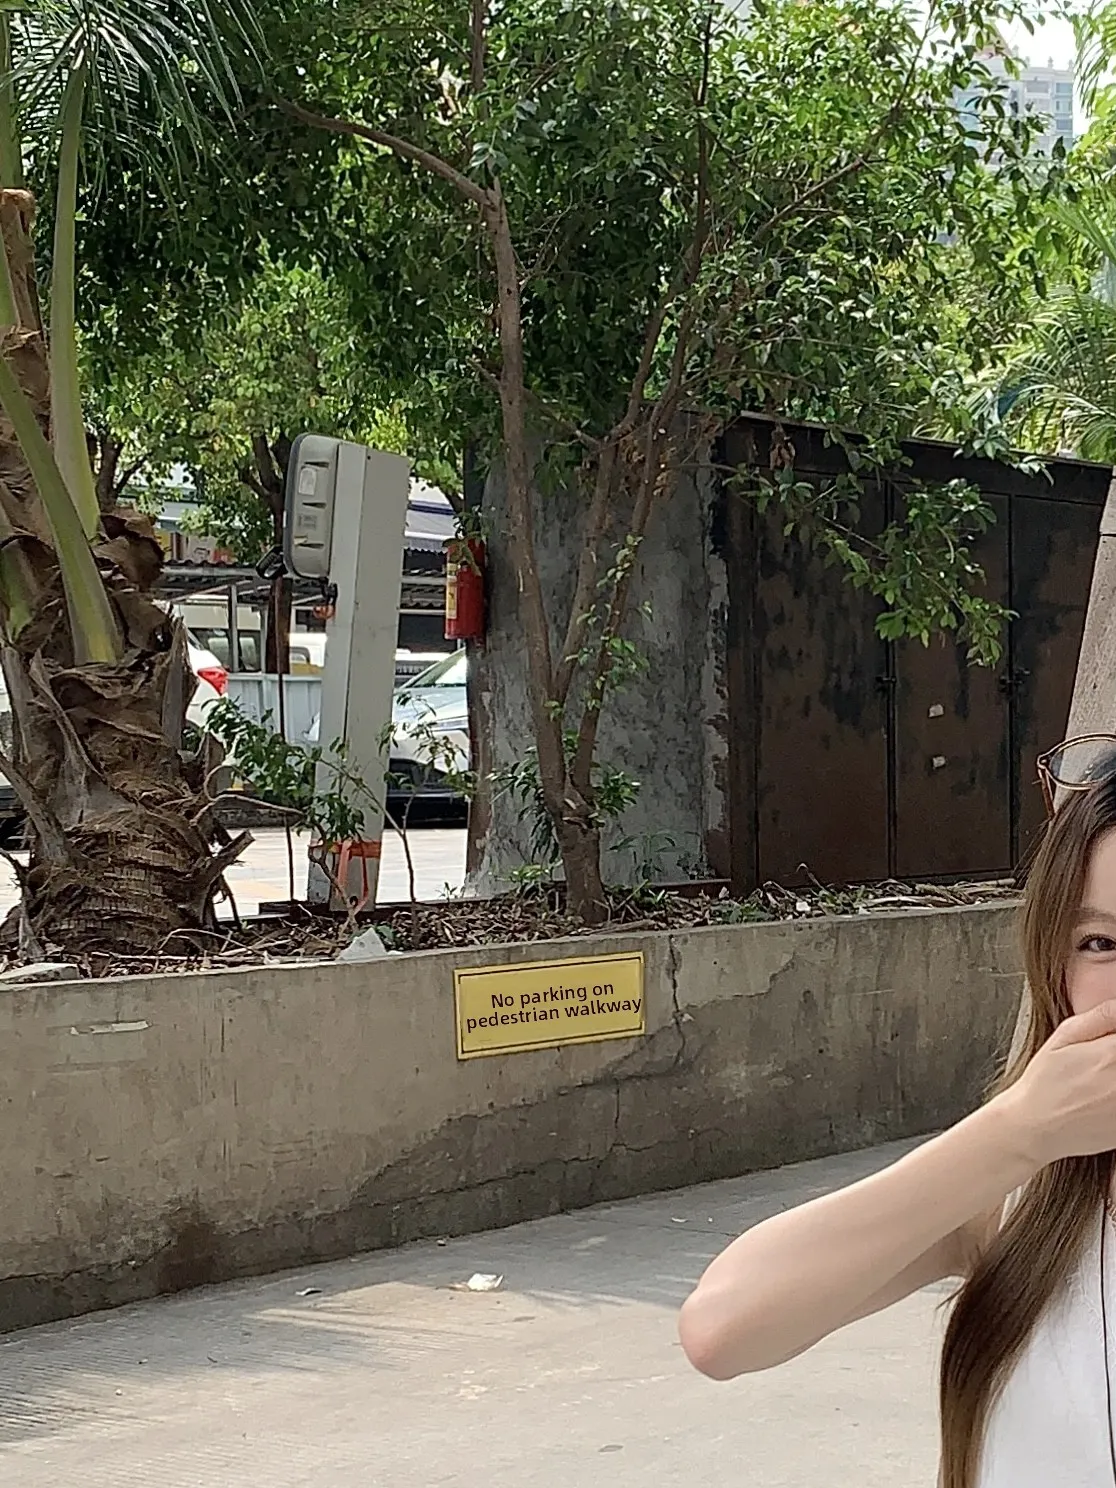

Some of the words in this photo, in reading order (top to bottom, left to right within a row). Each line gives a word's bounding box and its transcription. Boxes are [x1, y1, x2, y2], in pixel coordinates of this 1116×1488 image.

[491, 993, 515, 1009] No
[520, 985, 588, 1009] parking
[592, 983, 614, 996] on
[466, 1007, 560, 1033] pedestrian
[564, 998, 642, 1018] walkway
